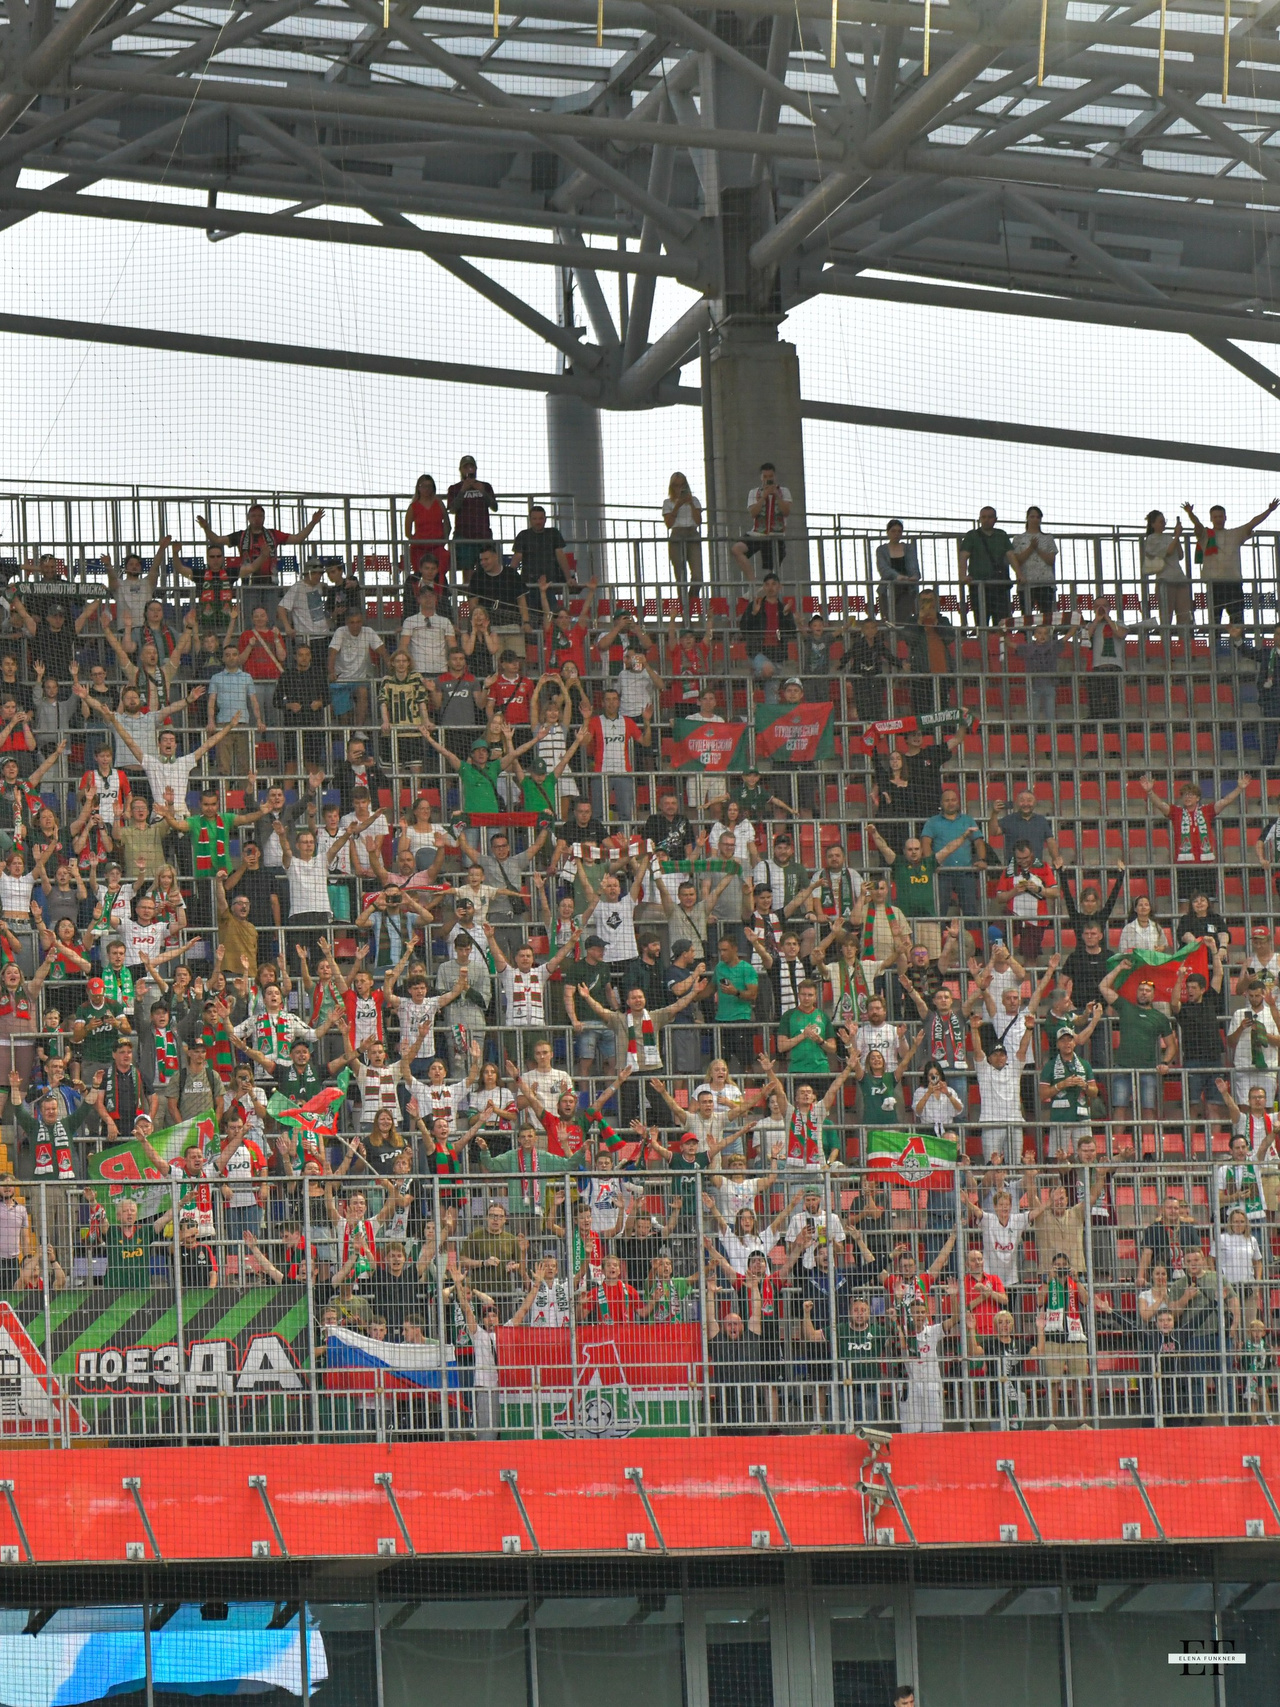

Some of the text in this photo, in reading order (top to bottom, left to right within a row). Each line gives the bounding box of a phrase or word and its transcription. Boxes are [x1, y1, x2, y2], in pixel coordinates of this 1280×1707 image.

[33, 583, 76, 594] ЛОКОМОТИВ
[688, 738, 732, 752] СТУДЕНЧЕСКИЙ
[786, 739, 809, 751] СЕКТОР
[700, 752, 721, 765] СЕКТОР
[78, 1333, 304, 1399] ПОЕЗДА
